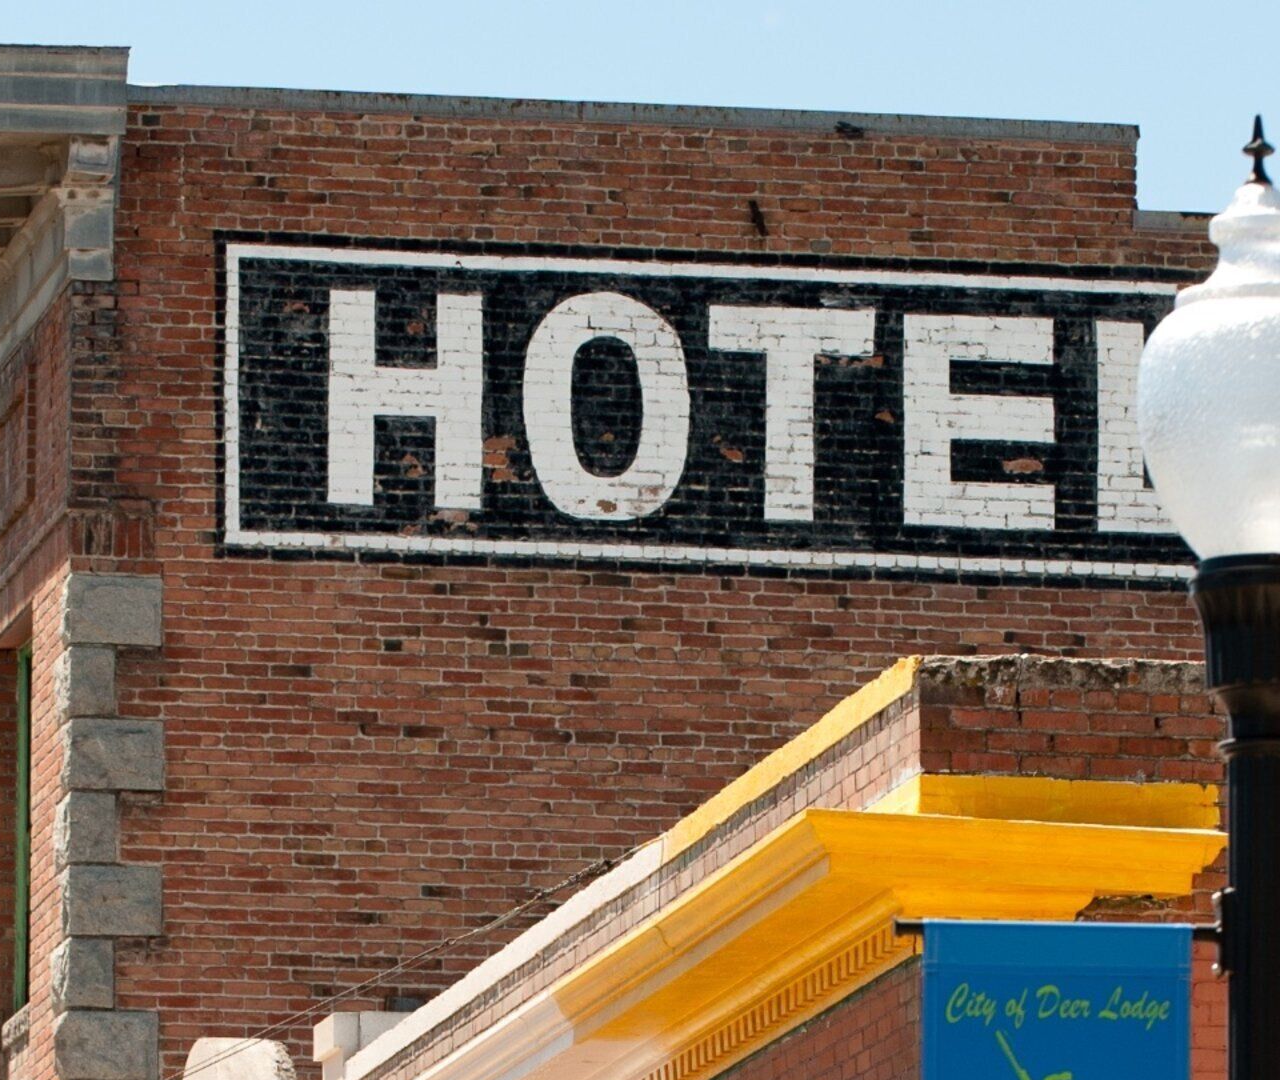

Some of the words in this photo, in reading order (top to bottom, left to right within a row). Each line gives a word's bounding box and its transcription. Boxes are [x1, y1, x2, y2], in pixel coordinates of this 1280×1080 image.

[327, 288, 1180, 534] HOTEL
[945, 982, 997, 1027] City
[1005, 988, 1028, 1029] of
[1036, 984, 1091, 1019] Deer
[1098, 984, 1170, 1030] Lodge
